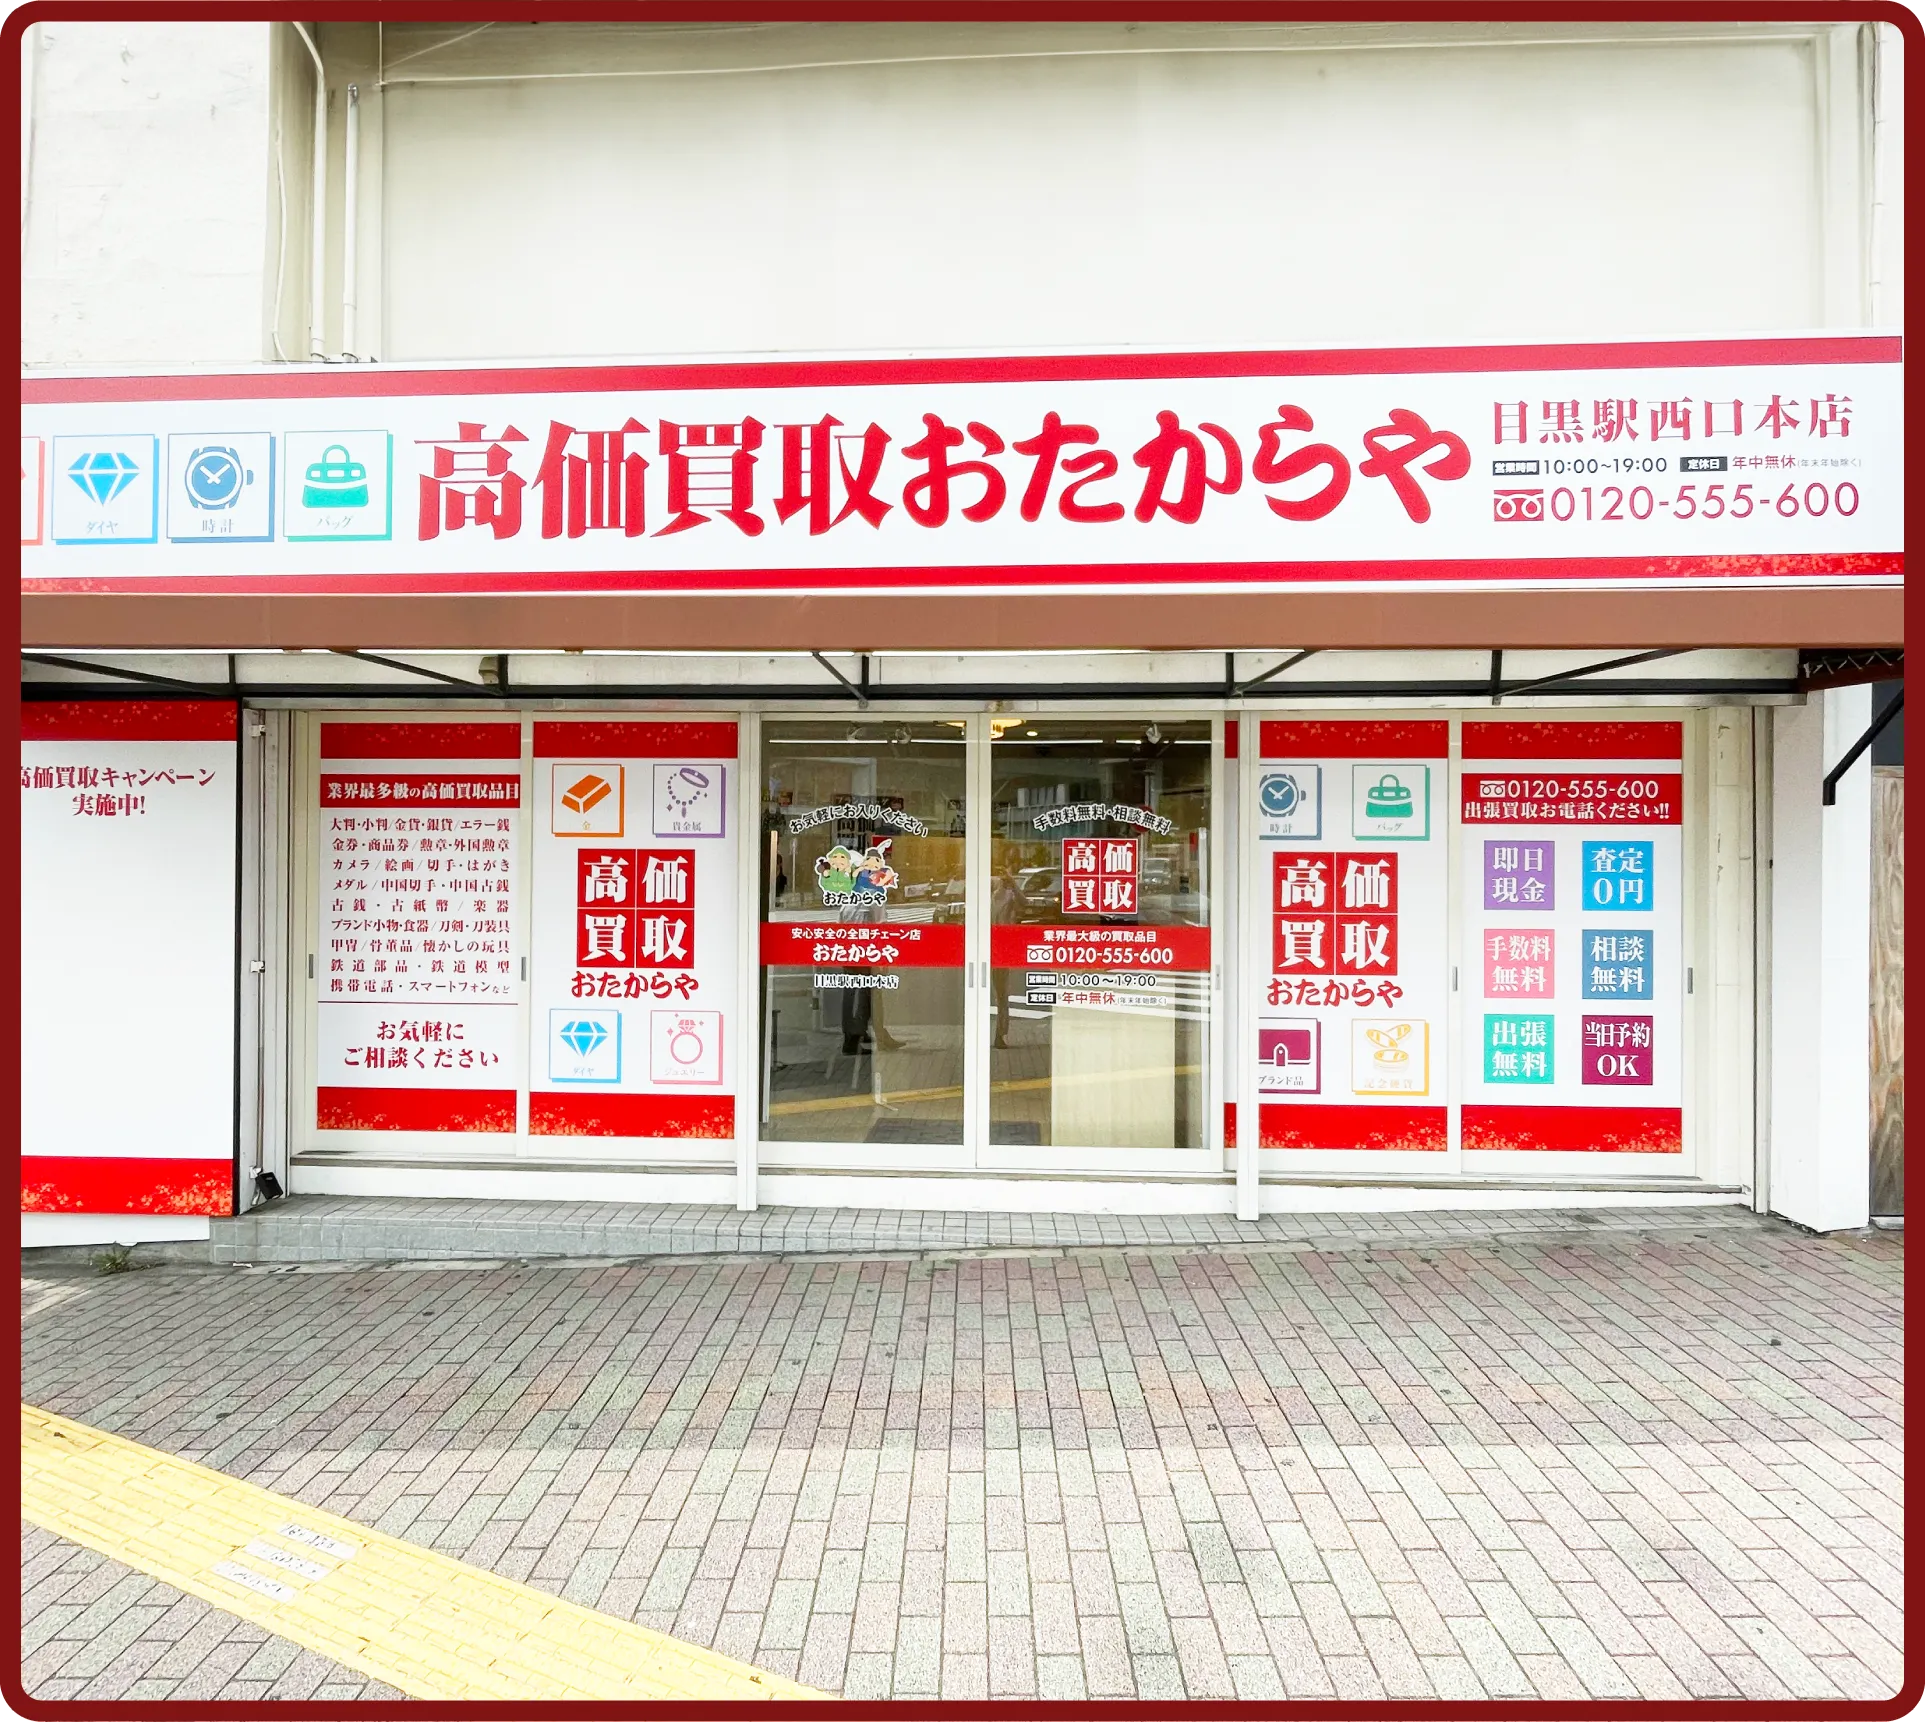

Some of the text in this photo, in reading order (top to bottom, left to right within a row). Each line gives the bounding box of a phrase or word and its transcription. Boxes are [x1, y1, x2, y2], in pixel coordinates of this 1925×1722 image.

[1494, 394, 1852, 444] 目黒駅西口本店
[414, 405, 1471, 541] 高価買取おたからや
[1688, 459, 1720, 470] 定休日
[1551, 482, 1859, 521] 0120-555-600
[87, 521, 118, 534] ダイヤ
[201, 517, 235, 534] 時計
[318, 516, 352, 529] バッグ
[327, 782, 519, 800] 業界最多級の高価買取品目
[1508, 780, 1659, 799] 0120-555-600
[73, 793, 145, 816] 実施中!
[1465, 802, 1670, 820] 出張買取お電話ください!!
[582, 820, 591, 830] 金
[673, 821, 702, 831] 貴金属
[789, 804, 928, 837] お気軽にお入りください
[1033, 804, 1172, 835] 手数料無料・相談無料
[1269, 823, 1293, 834] 時計
[1067, 842, 1133, 873] 高価
[1493, 847, 1543, 873] 即日
[1591, 848, 1645, 873] 査定
[584, 855, 688, 903] 高価
[1279, 859, 1390, 908] 高価
[1492, 877, 1546, 903] 現金
[1594, 878, 1644, 904] 0円
[824, 892, 886, 905] おたからや
[1067, 879, 1133, 909] 買取
[582, 914, 688, 962] 買取
[792, 928, 921, 940] 安心安全の全国チェーン店
[1044, 930, 1157, 942] 業界最大級の買取品目
[1279, 920, 1390, 969] 買取
[813, 943, 899, 962] おたからや
[1056, 948, 1173, 964] 0120-555-600
[1487, 935, 1551, 962] 手数料
[1591, 936, 1645, 962] 相談
[571, 971, 699, 1000] おたからや
[814, 974, 899, 988] 目黒駅西口本店
[1492, 966, 1547, 992] 無料
[1591, 967, 1645, 992] 無料
[1030, 994, 1053, 1003] 定休日
[1267, 978, 1403, 1008] おたからや
[377, 1020, 463, 1042] お気軽に
[1492, 1021, 1547, 1047] 出張
[1585, 1021, 1651, 1048] 当日予約
[345, 1046, 498, 1068] ご相談ください
[1492, 1051, 1547, 1077] 無料
[1597, 1055, 1639, 1078] OK
[573, 1067, 594, 1076] ダイヤ
[1259, 1076, 1303, 1086] ブランド品
